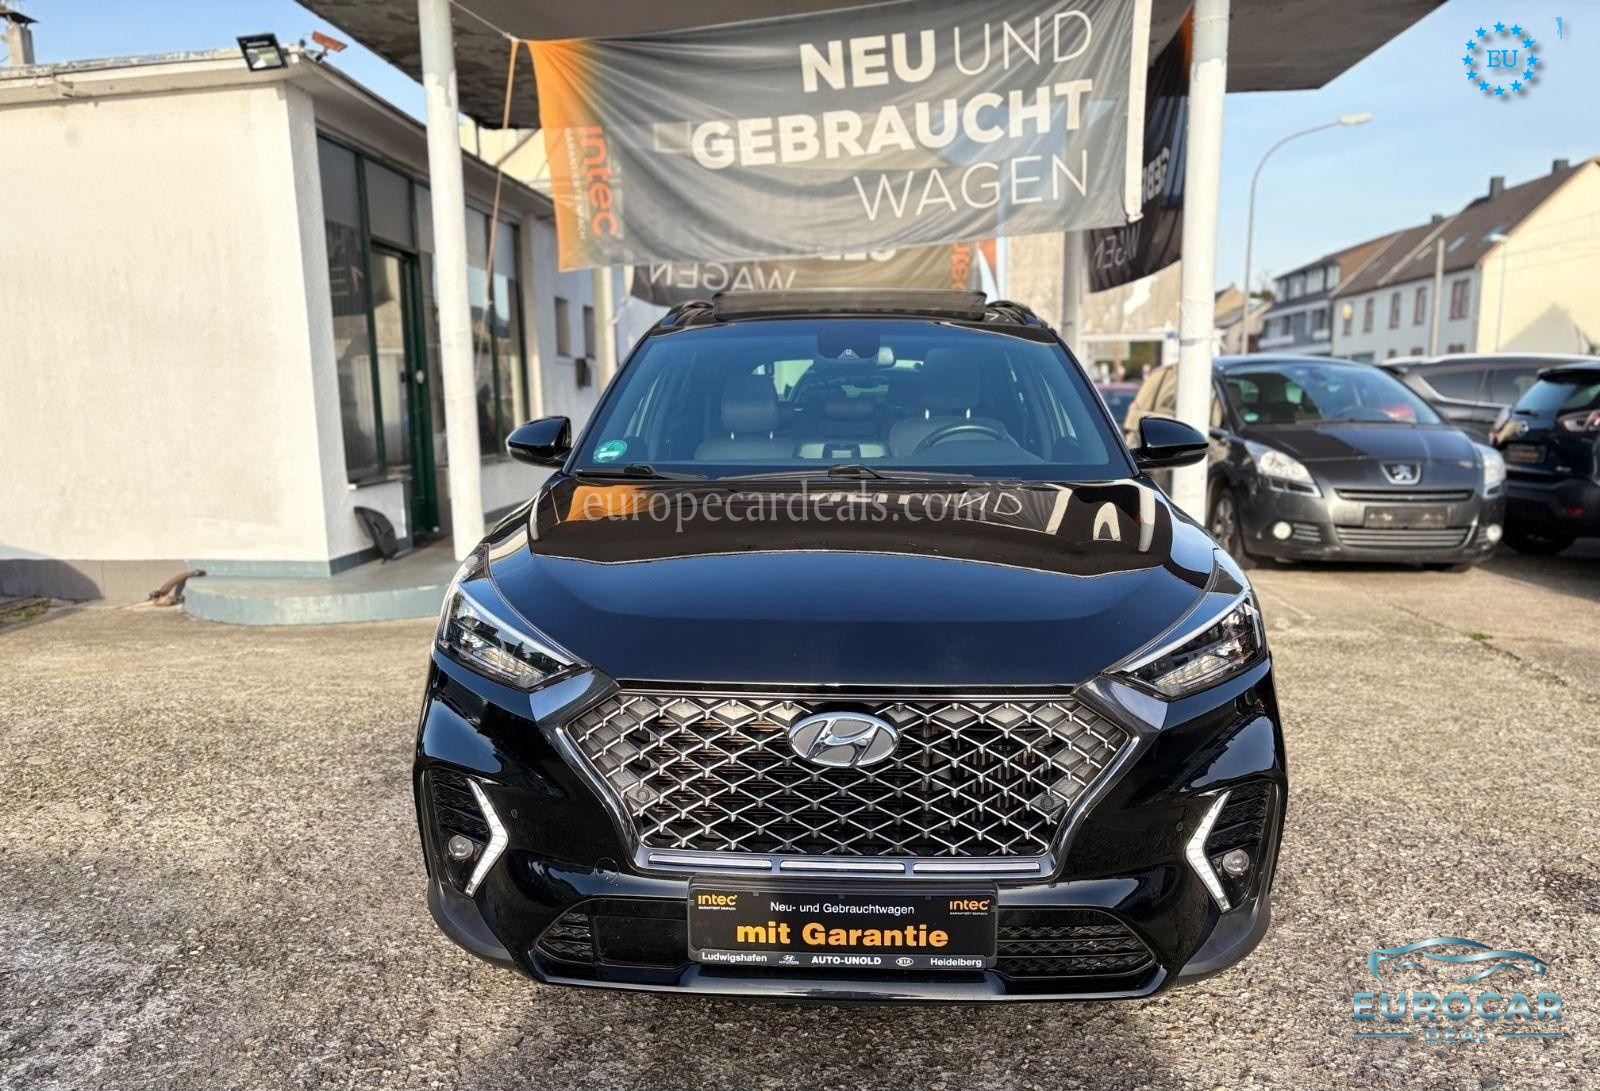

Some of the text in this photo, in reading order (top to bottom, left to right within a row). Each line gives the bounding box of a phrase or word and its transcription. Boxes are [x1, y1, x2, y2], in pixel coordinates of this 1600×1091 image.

[799, 9, 1093, 93] NEU UND
[691, 79, 1093, 169] GEBRAUCHT
[579, 126, 618, 238] intec
[853, 149, 1088, 221] WAGEN
[698, 894, 738, 906] intec
[949, 900, 990, 910] intec
[770, 902, 915, 916] Neu- und Gebrauchtwagen
[737, 921, 949, 947] mit Garantie
[701, 952, 768, 963] Ludwigshafen
[811, 956, 882, 965] AUTO-UNOLD
[930, 958, 982, 967] Heidelberg
